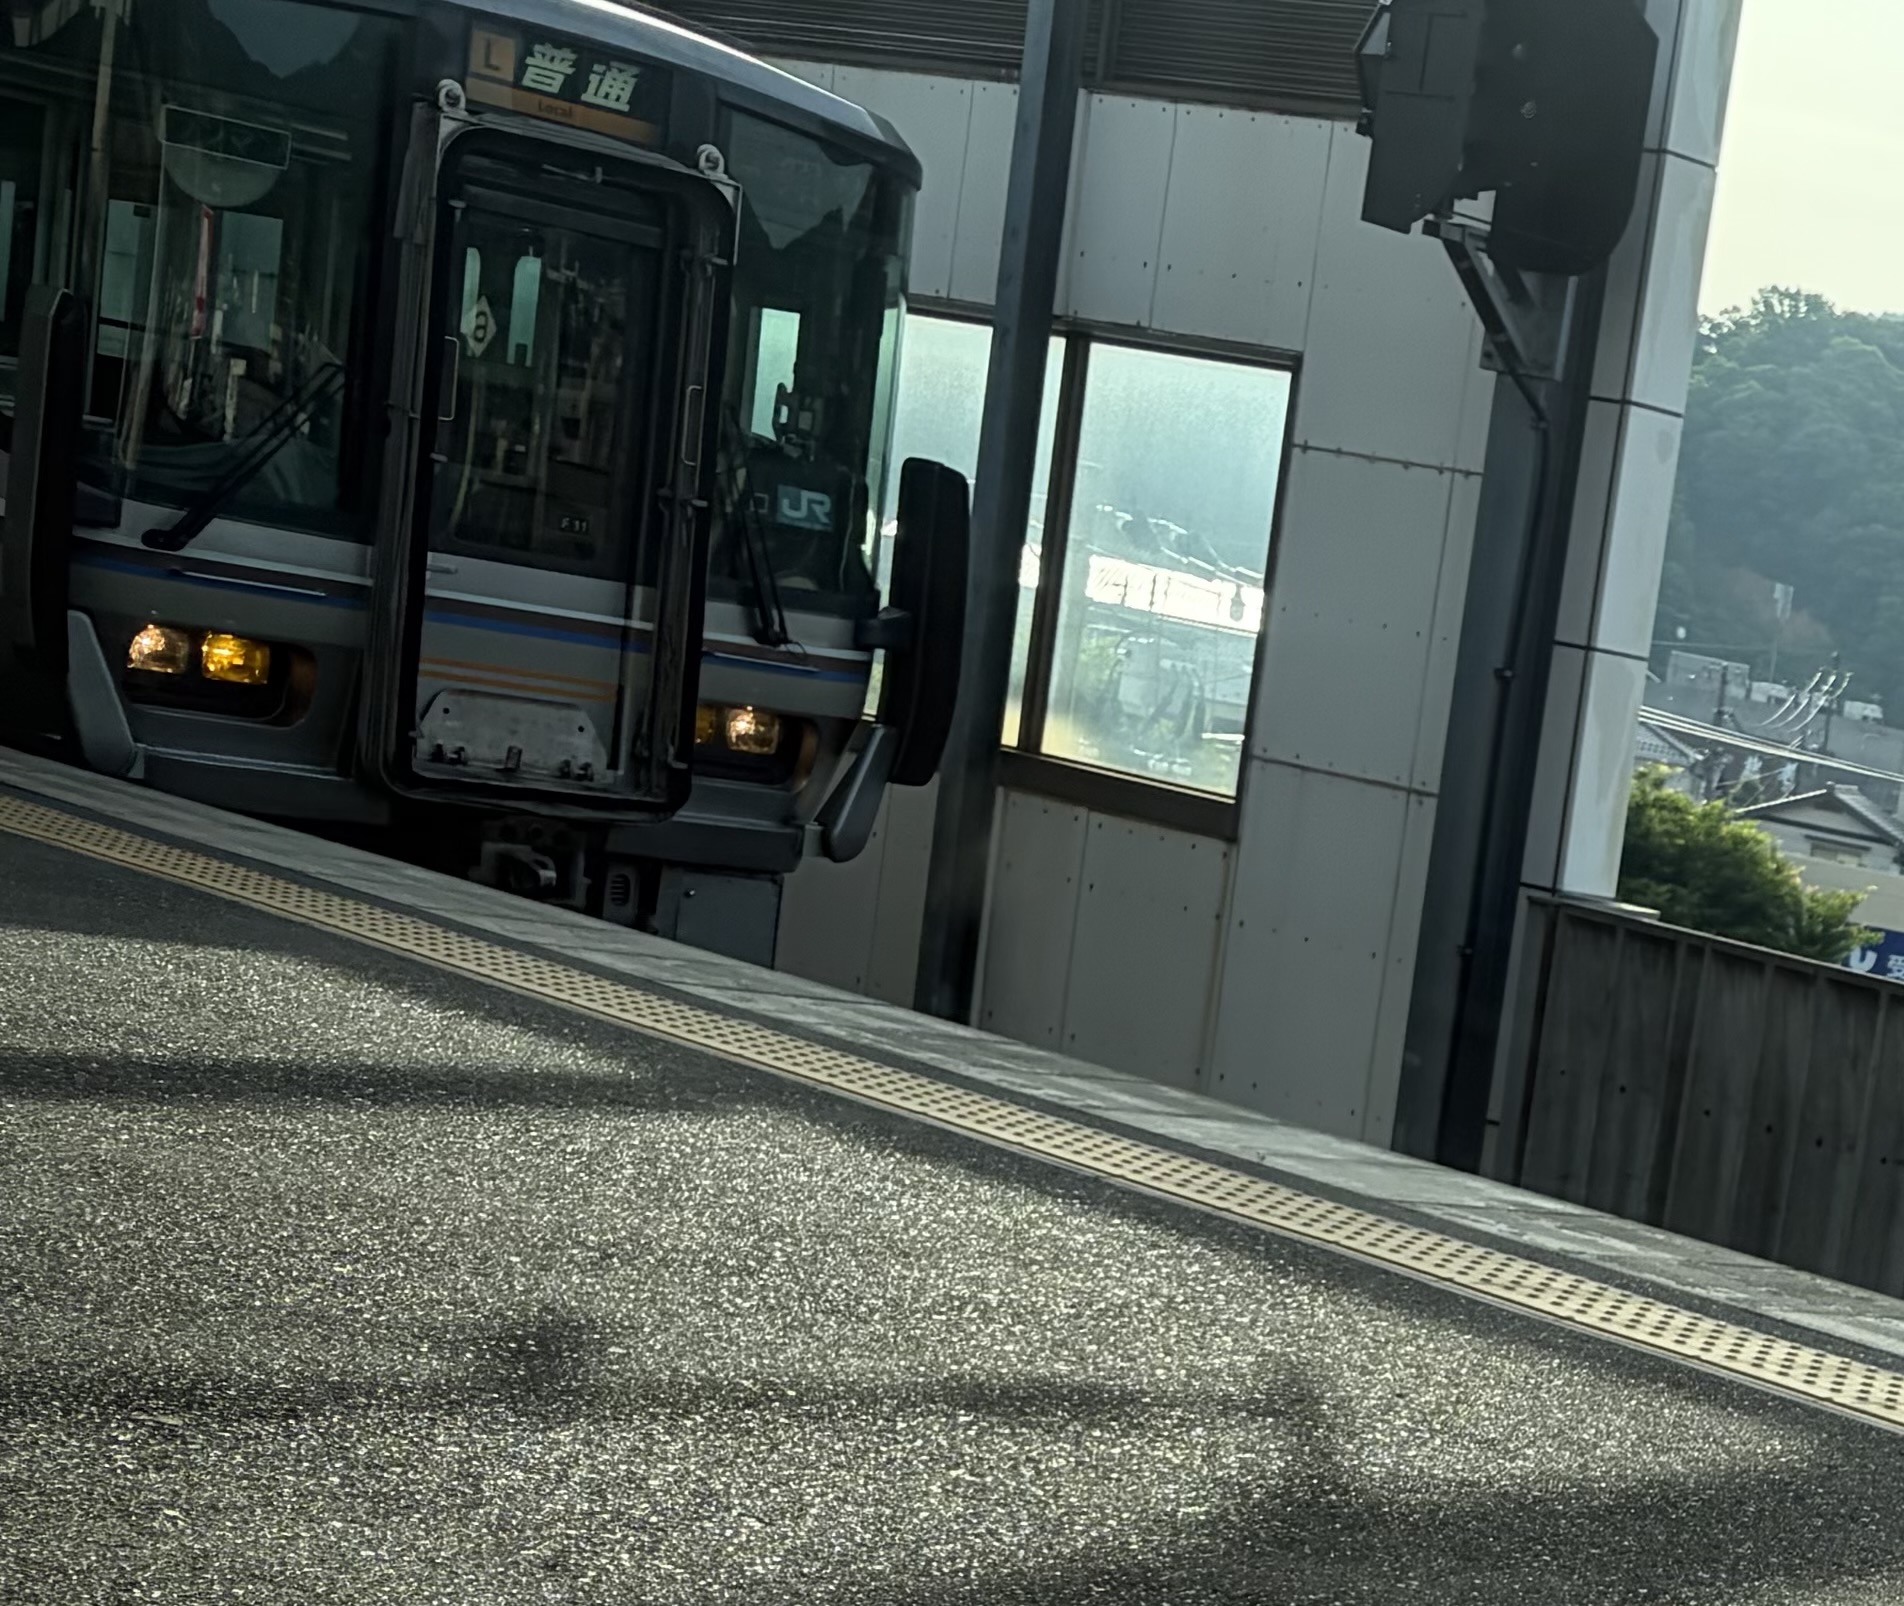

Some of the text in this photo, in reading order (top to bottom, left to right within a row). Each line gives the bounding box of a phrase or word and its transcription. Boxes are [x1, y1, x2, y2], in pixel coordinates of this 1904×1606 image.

[484, 38, 500, 71] L
[521, 43, 641, 112] 普通
[781, 490, 832, 524] JR
